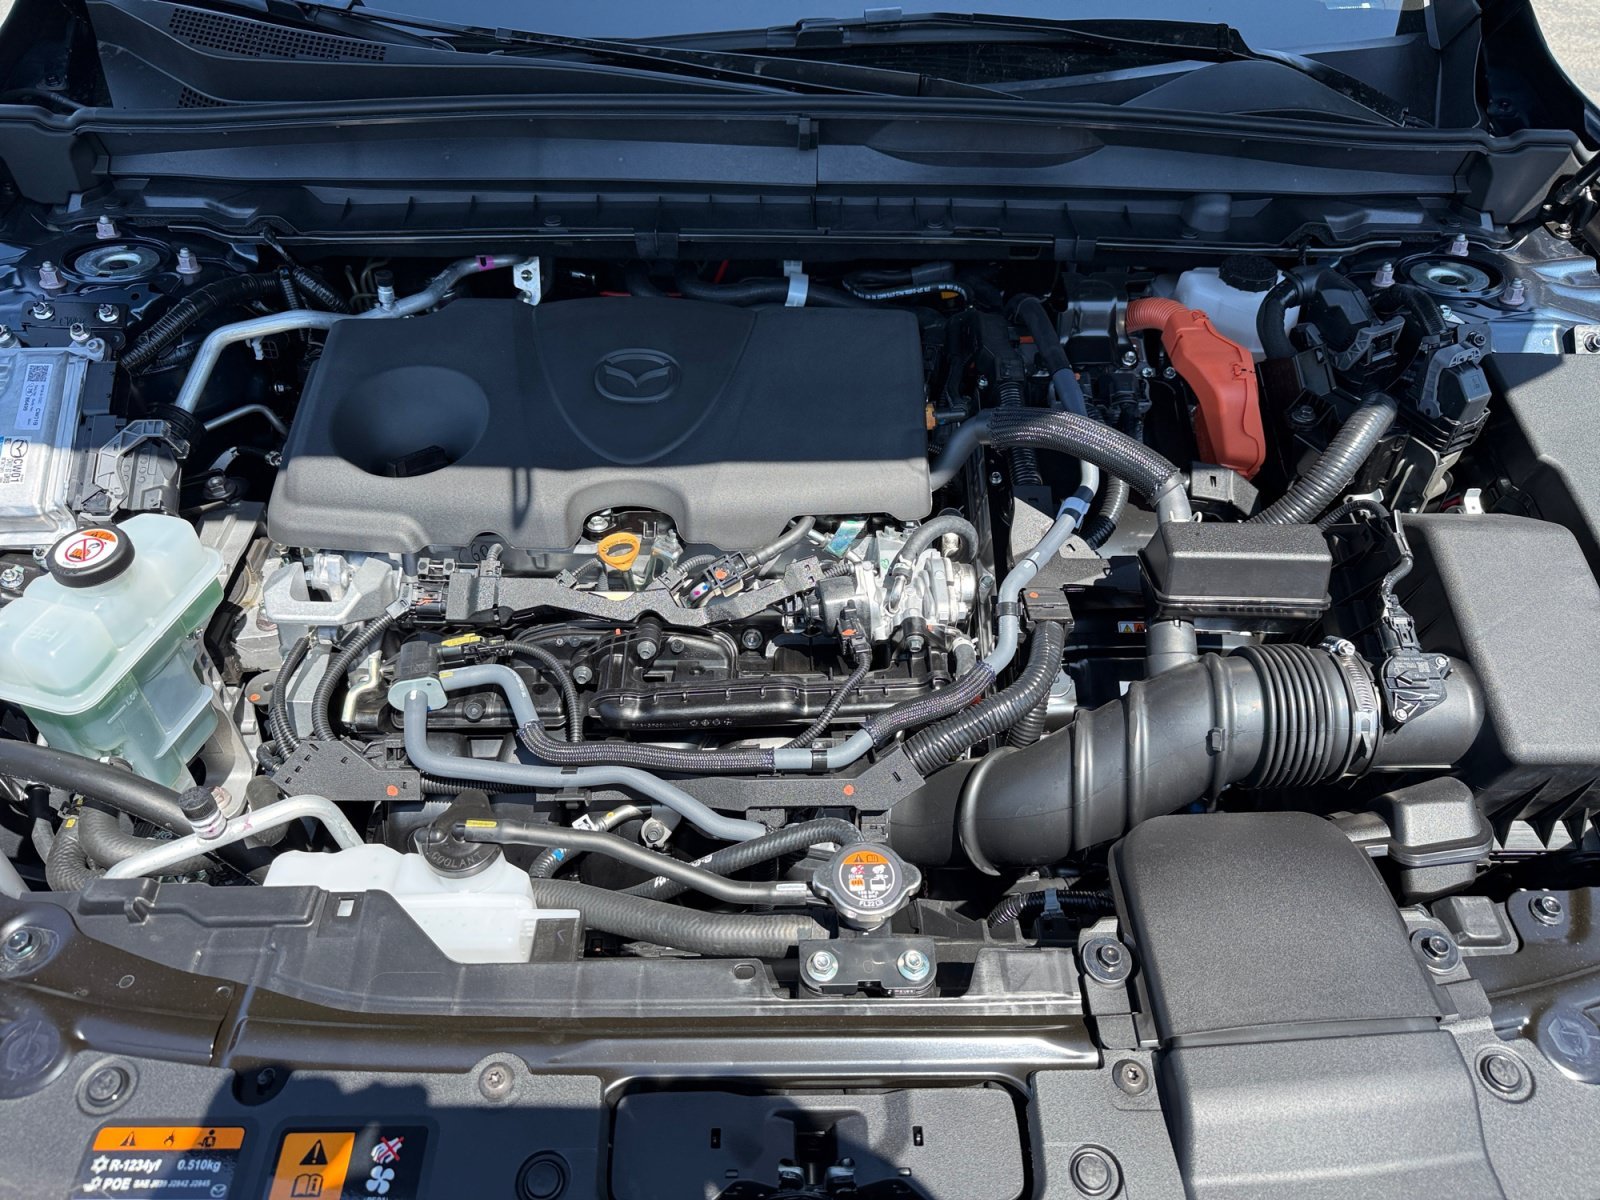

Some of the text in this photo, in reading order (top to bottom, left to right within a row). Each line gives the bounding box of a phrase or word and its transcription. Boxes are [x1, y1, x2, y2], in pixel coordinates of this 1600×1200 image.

[431, 852, 481, 868] COOLANT
[109, 1159, 221, 1173] R-1234yf 0.510kg
[102, 1177, 132, 1191] POE
